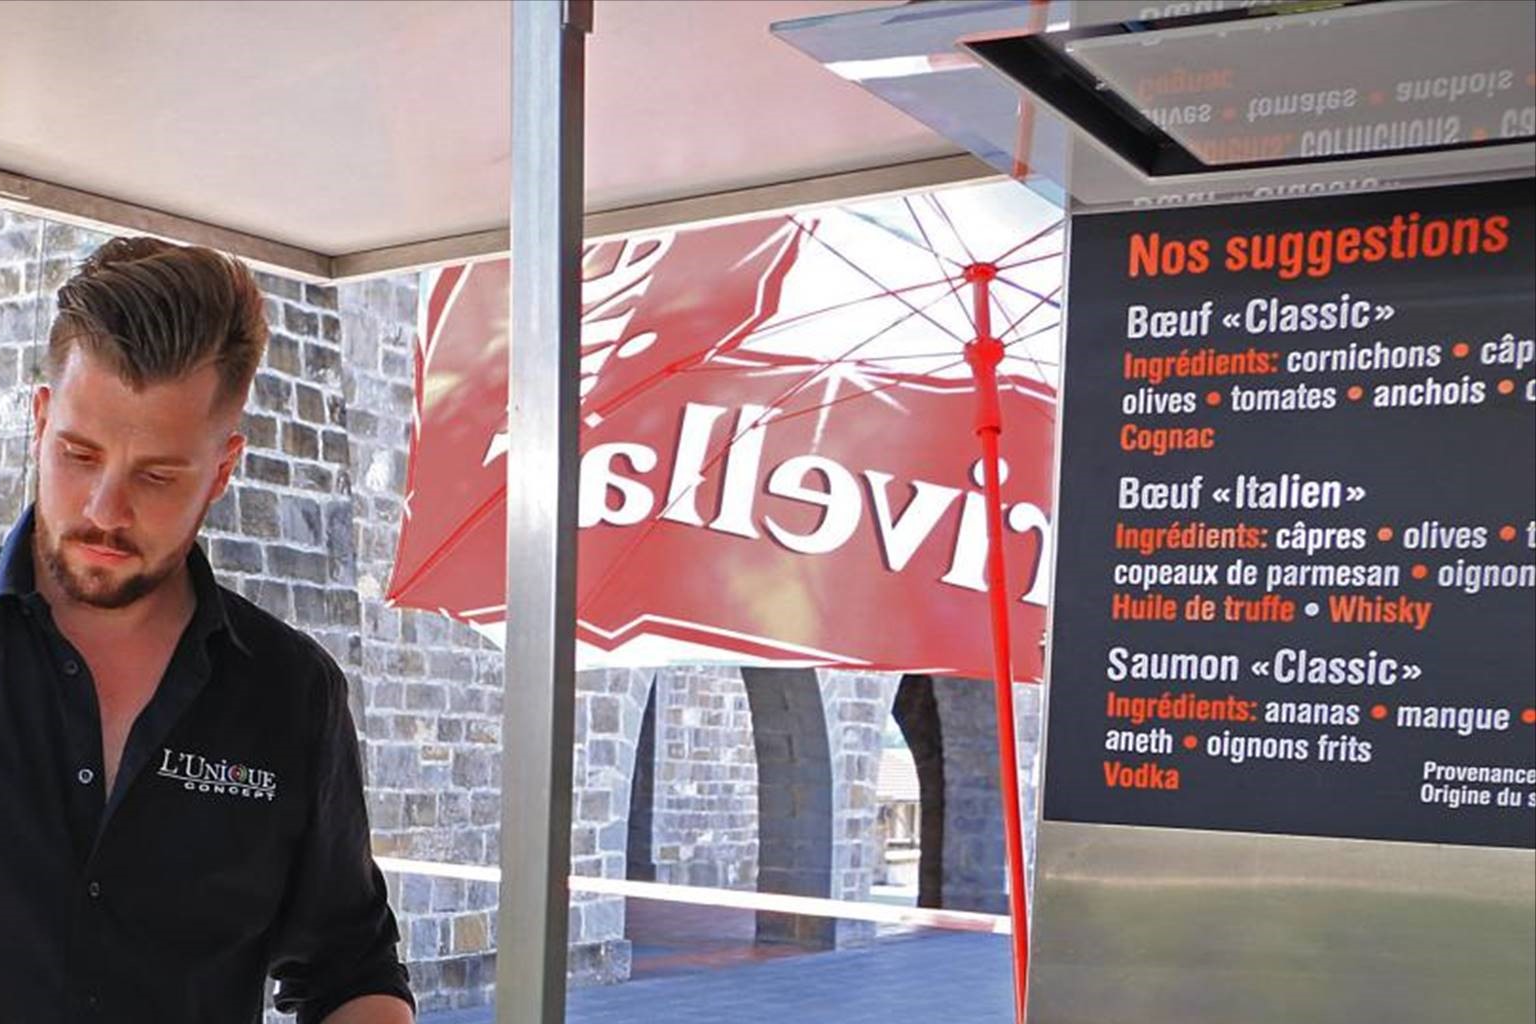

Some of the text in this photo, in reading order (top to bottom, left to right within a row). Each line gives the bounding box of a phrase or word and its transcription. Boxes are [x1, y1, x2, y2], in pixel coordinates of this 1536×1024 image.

[1129, 213, 1508, 279] Nos suggestions
[1128, 301, 1212, 338] Bœuf
[1124, 349, 1278, 384] Ingrédients:
[1287, 342, 1441, 372] cornichons
[1123, 388, 1196, 414] olives
[1231, 383, 1336, 411] tomates
[1374, 376, 1485, 407] anchois
[1120, 424, 1215, 456] Cognac
[1119, 476, 1203, 509] Bœuf
[1116, 522, 1268, 555] Ingrédients:
[1276, 521, 1366, 555] câpres
[1404, 521, 1487, 548] olives
[1115, 559, 1535, 593] copeaux de parmesan oignon
[1112, 594, 1432, 630] Huile de truffe Whisky
[1107, 647, 1239, 681] Saumon
[1107, 692, 1510, 735] Ingrédients: ananas mangue
[1105, 728, 1371, 763] aneth oignons frits
[1104, 762, 1179, 789] Vodka
[1424, 761, 1536, 784] Provenance
[184, 782, 275, 801] CONCEPT
[1421, 784, 1490, 808] Origine
[1497, 787, 1521, 806] du
